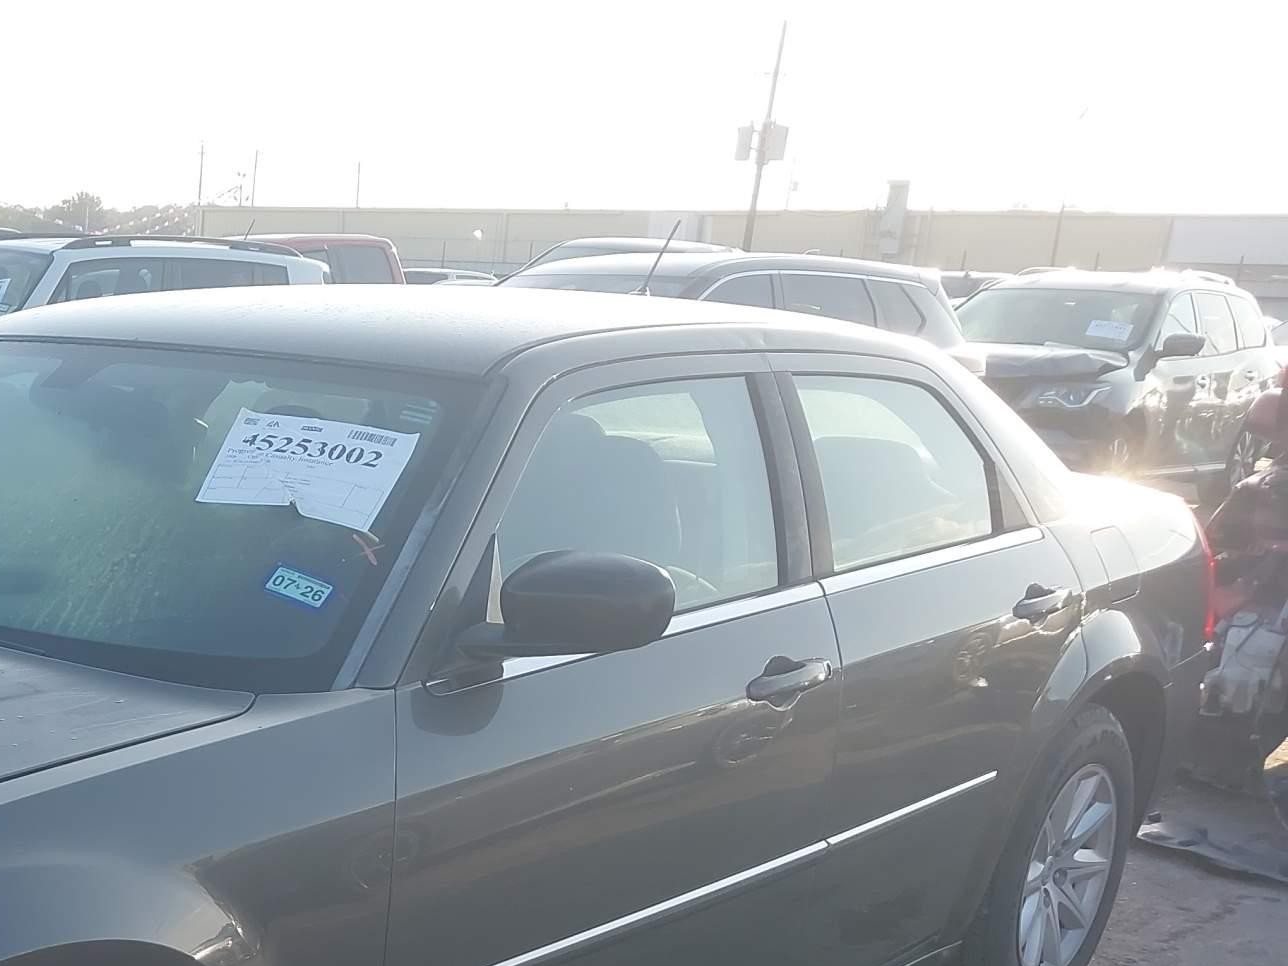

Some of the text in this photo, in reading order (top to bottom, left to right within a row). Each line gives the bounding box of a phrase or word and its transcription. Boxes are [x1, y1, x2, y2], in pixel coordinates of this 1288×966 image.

[242, 432, 383, 468] 45253002
[272, 575, 296, 589] 07
[300, 585, 325, 602] 26
